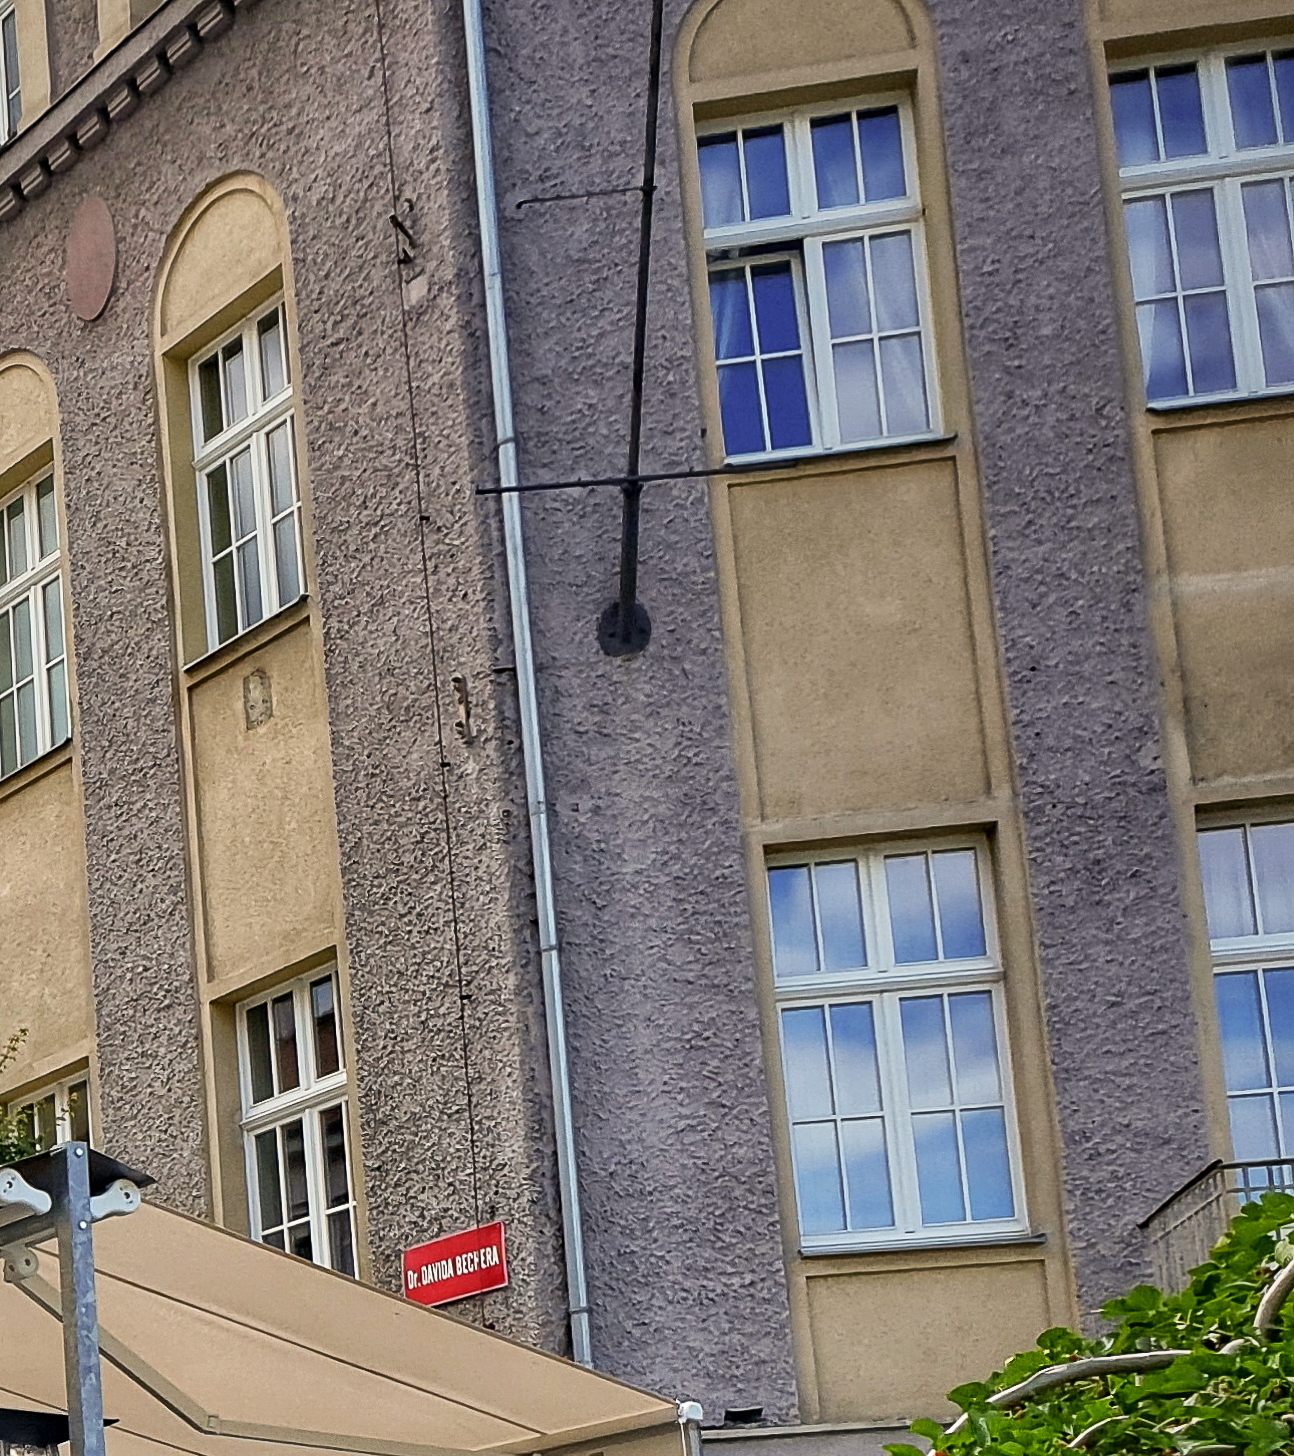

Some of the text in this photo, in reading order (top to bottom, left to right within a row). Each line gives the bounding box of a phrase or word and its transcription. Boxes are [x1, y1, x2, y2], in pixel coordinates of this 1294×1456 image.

[407, 1245, 500, 1290] Dr. DAVIDA BECHERA
